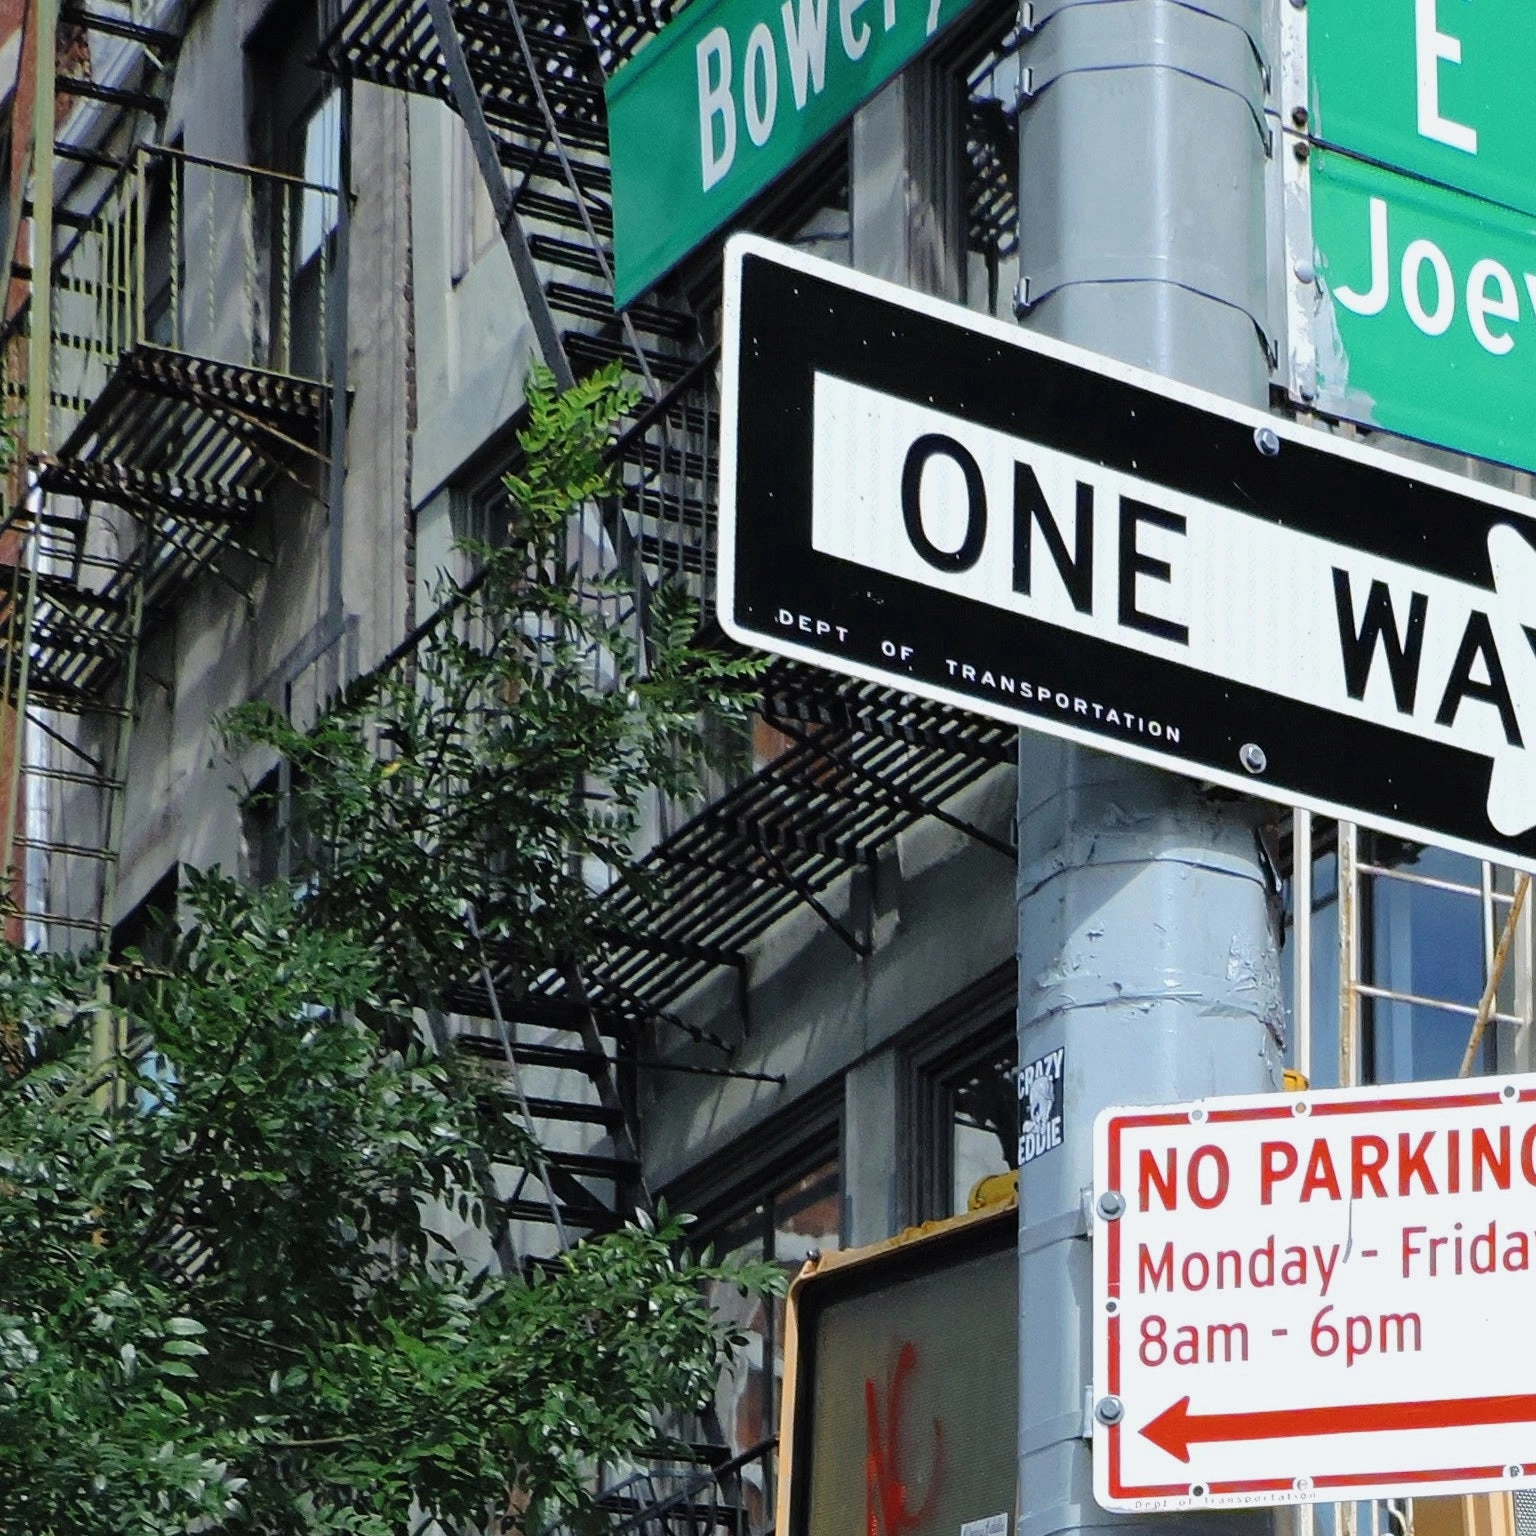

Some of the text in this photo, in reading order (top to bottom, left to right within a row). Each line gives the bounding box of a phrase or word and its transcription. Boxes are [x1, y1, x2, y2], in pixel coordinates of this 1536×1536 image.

[1415, 0, 1477, 155] E
[900, 432, 1190, 646] ONE
[778, 608, 1181, 744] DEPT OF TRANSPORTATION
[1138, 1145, 1230, 1213] NO
[1138, 1235, 1340, 1297] Monday
[1138, 1314, 1249, 1368] 8am
[1310, 1304, 1422, 1368] 6pm
